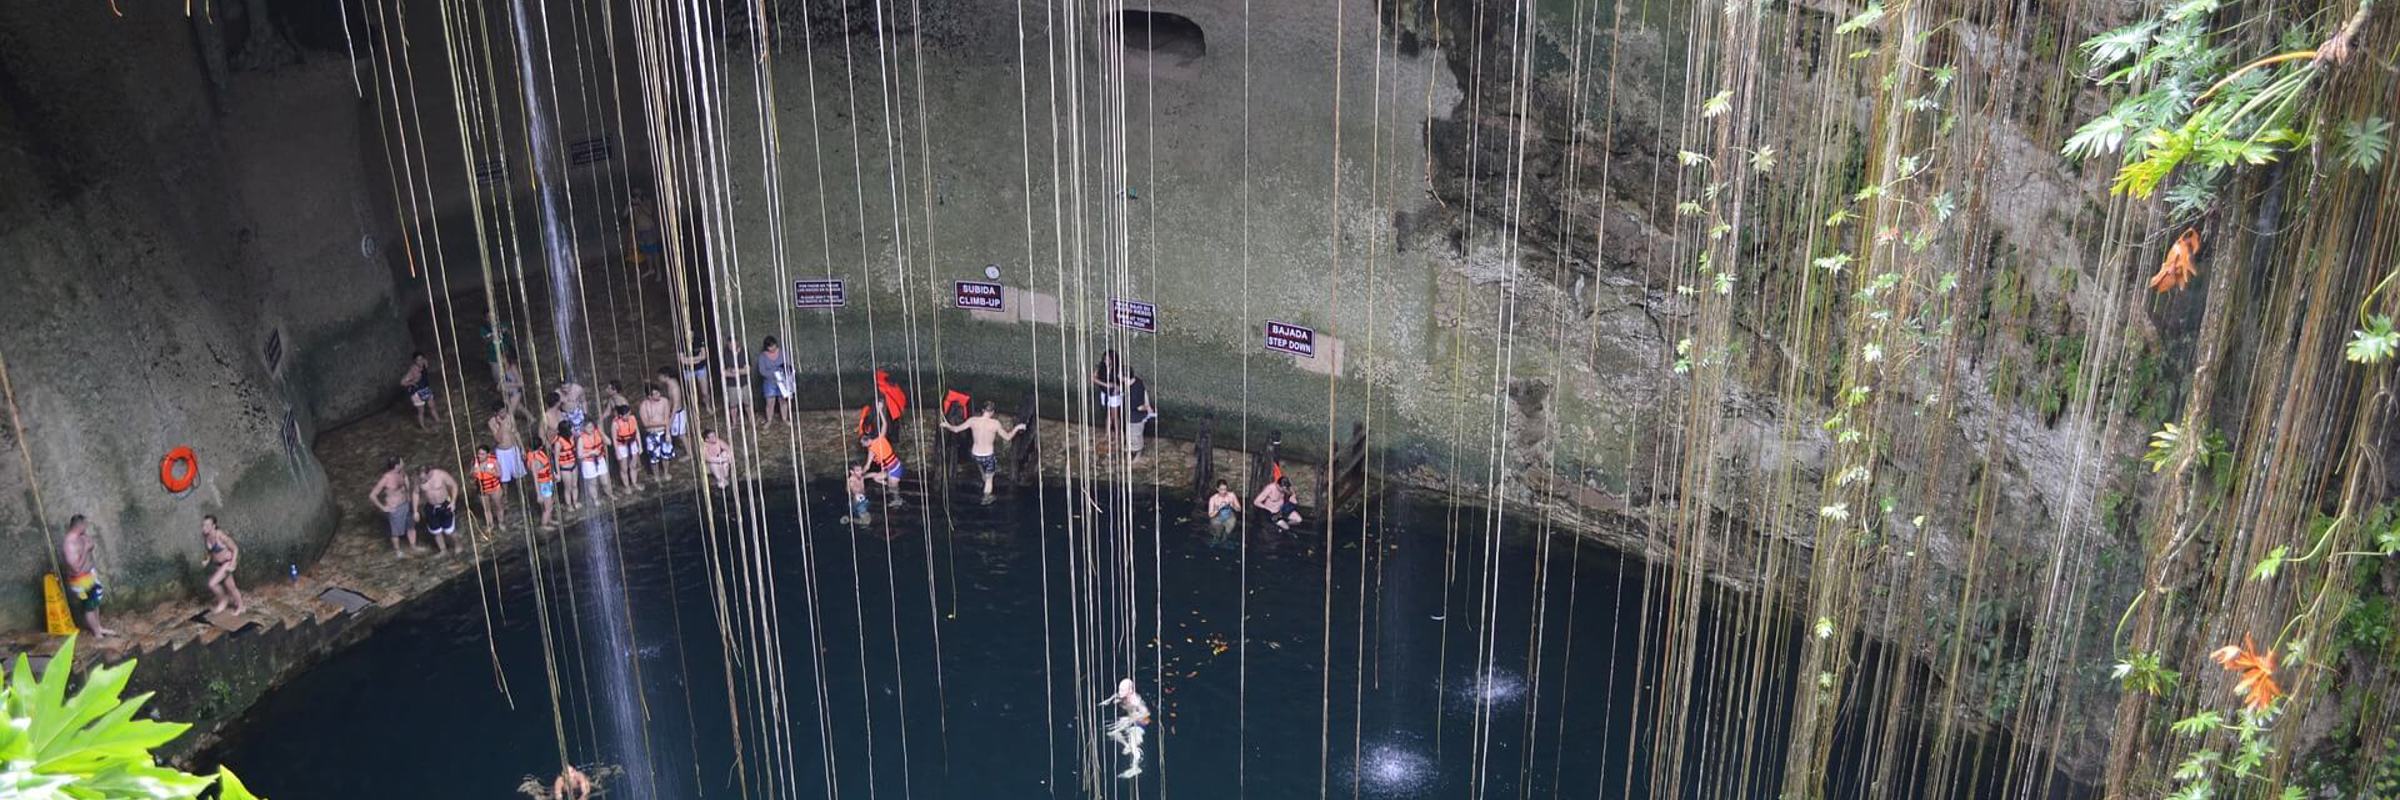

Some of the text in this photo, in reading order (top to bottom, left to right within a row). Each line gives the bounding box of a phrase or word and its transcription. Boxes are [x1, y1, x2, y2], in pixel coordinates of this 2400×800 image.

[963, 284, 995, 295] SUBIDA
[959, 296, 1001, 307] CLIMB-UP
[1272, 325, 1308, 340] BAJADA
[1268, 336, 1311, 353] STEP DOWN
